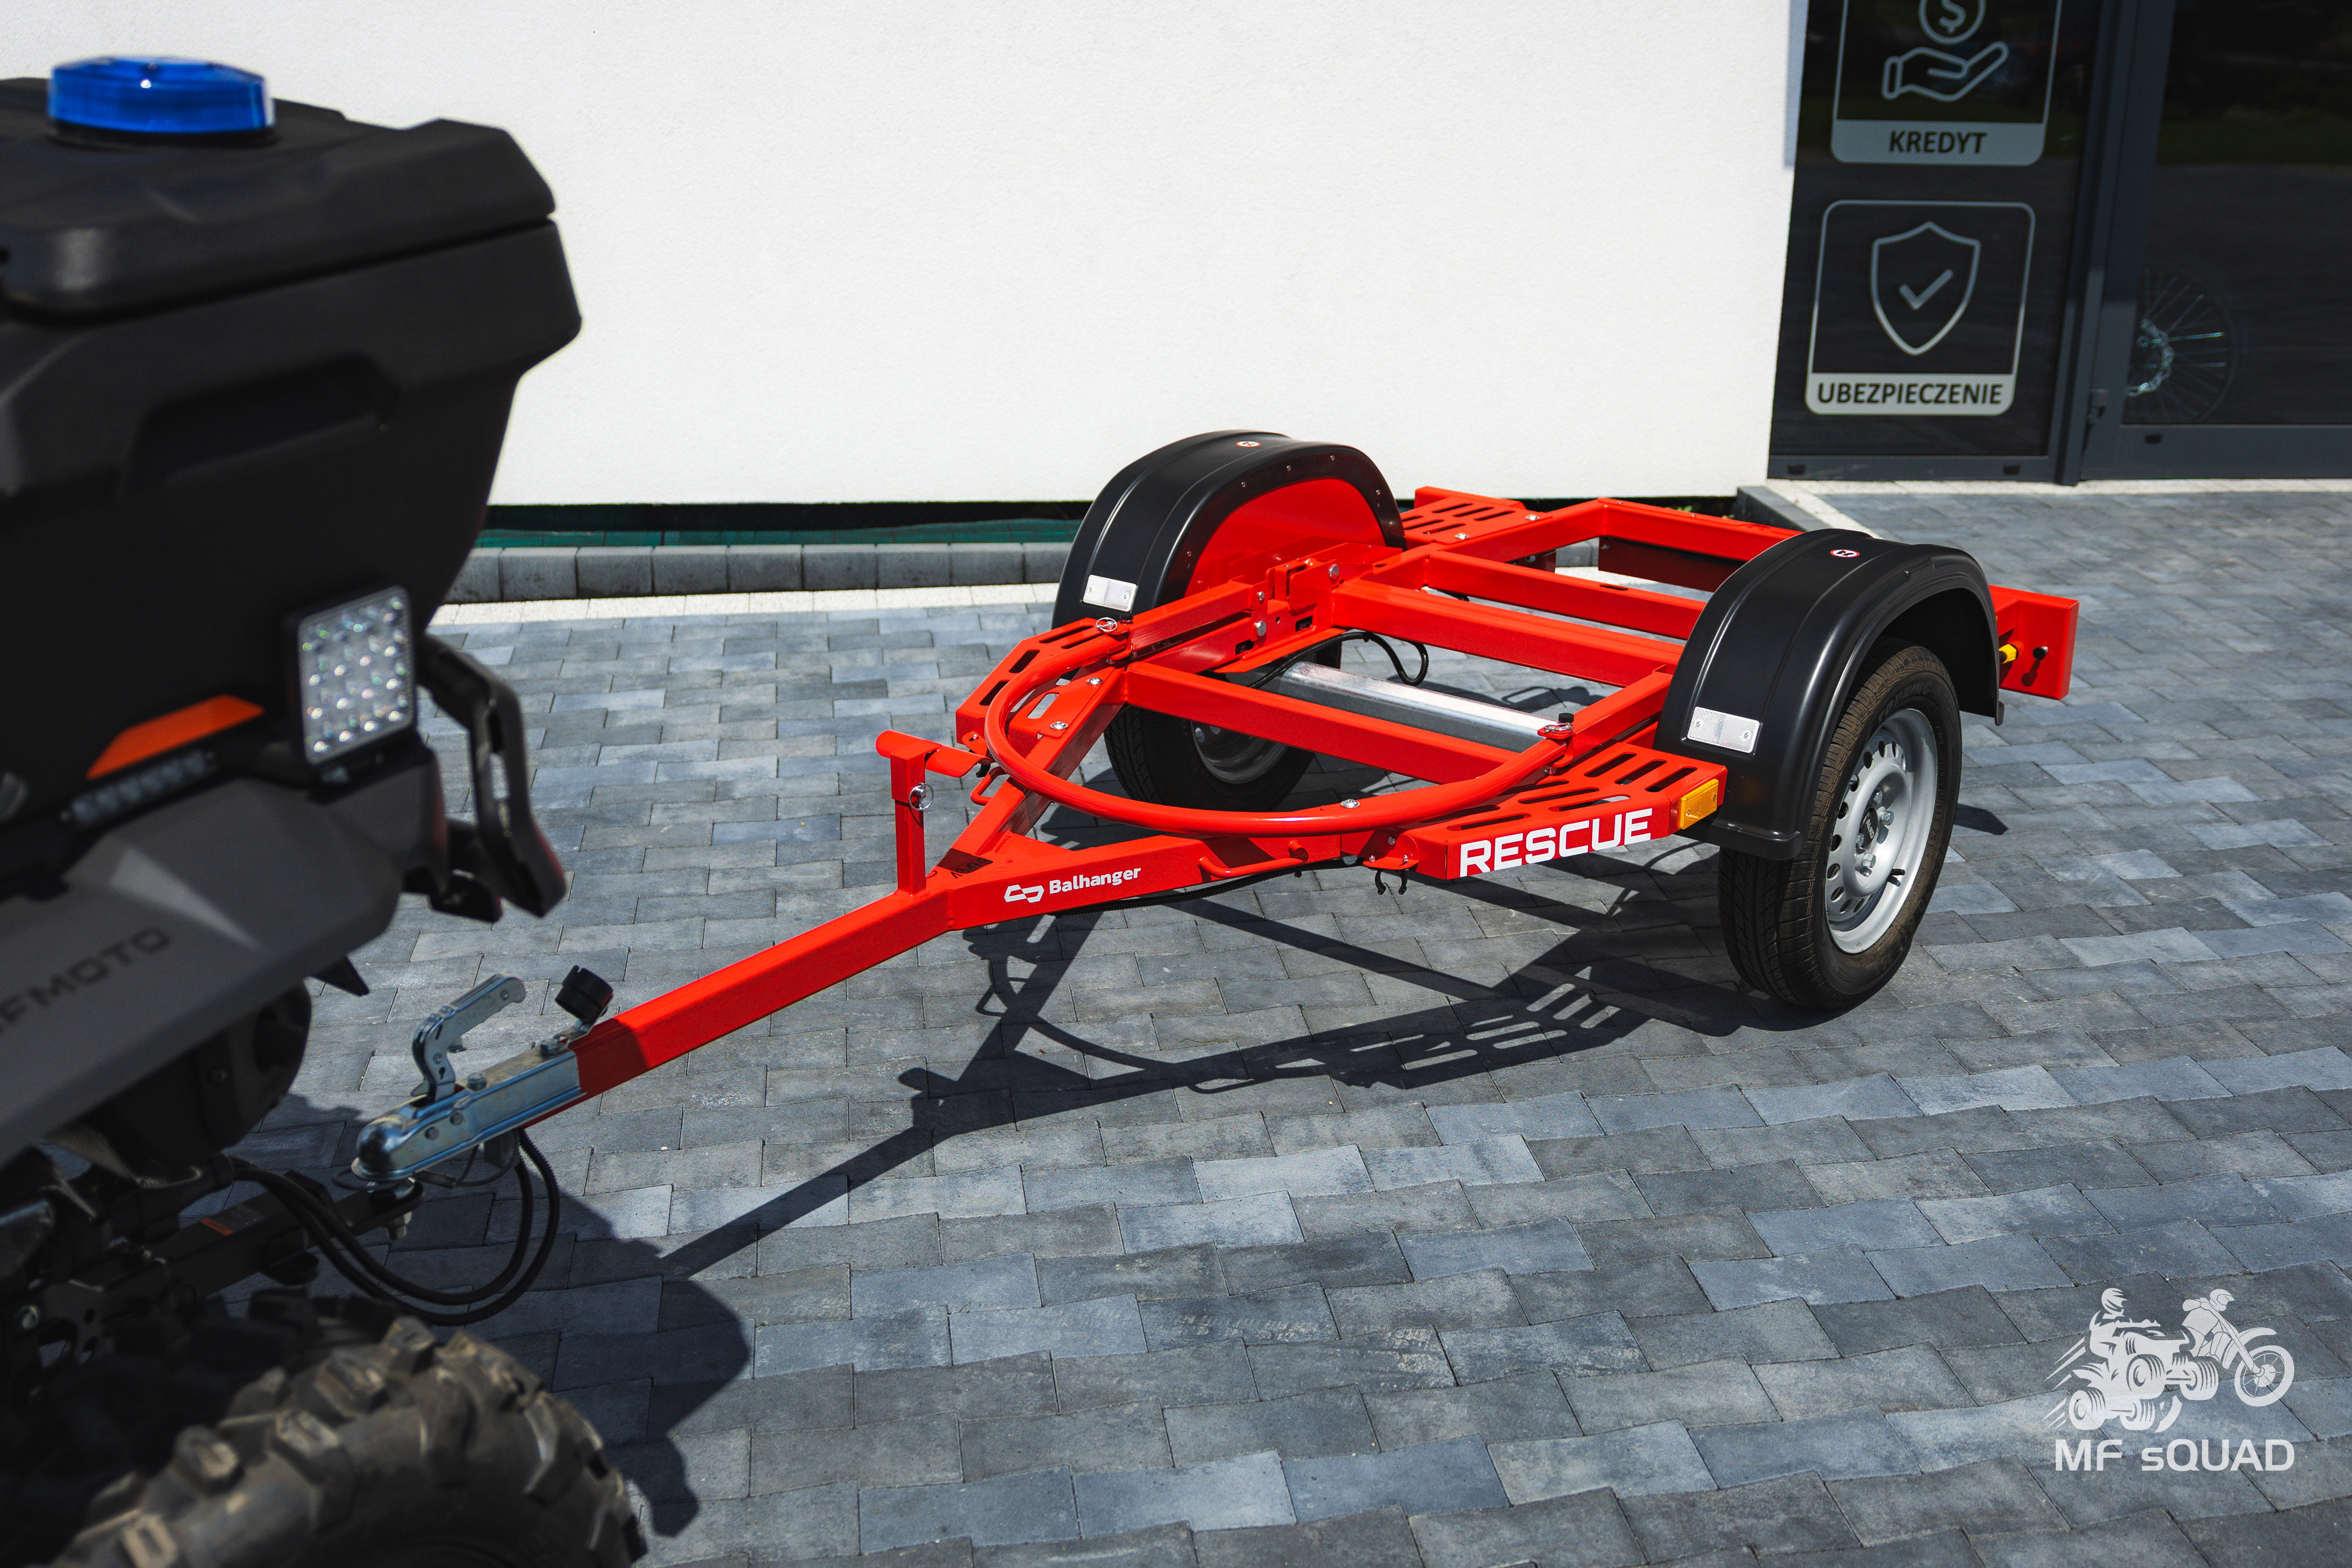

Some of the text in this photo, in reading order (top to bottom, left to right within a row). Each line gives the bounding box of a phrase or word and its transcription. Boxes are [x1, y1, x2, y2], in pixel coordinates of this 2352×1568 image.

[1888, 130, 1987, 154] KREDYT
[1817, 383, 2003, 405] UBEZPIECZENIE
[1459, 808, 1653, 877] RESCUE
[1049, 868, 1141, 895] Balhanger
[0, 926, 172, 1035] FMOTO
